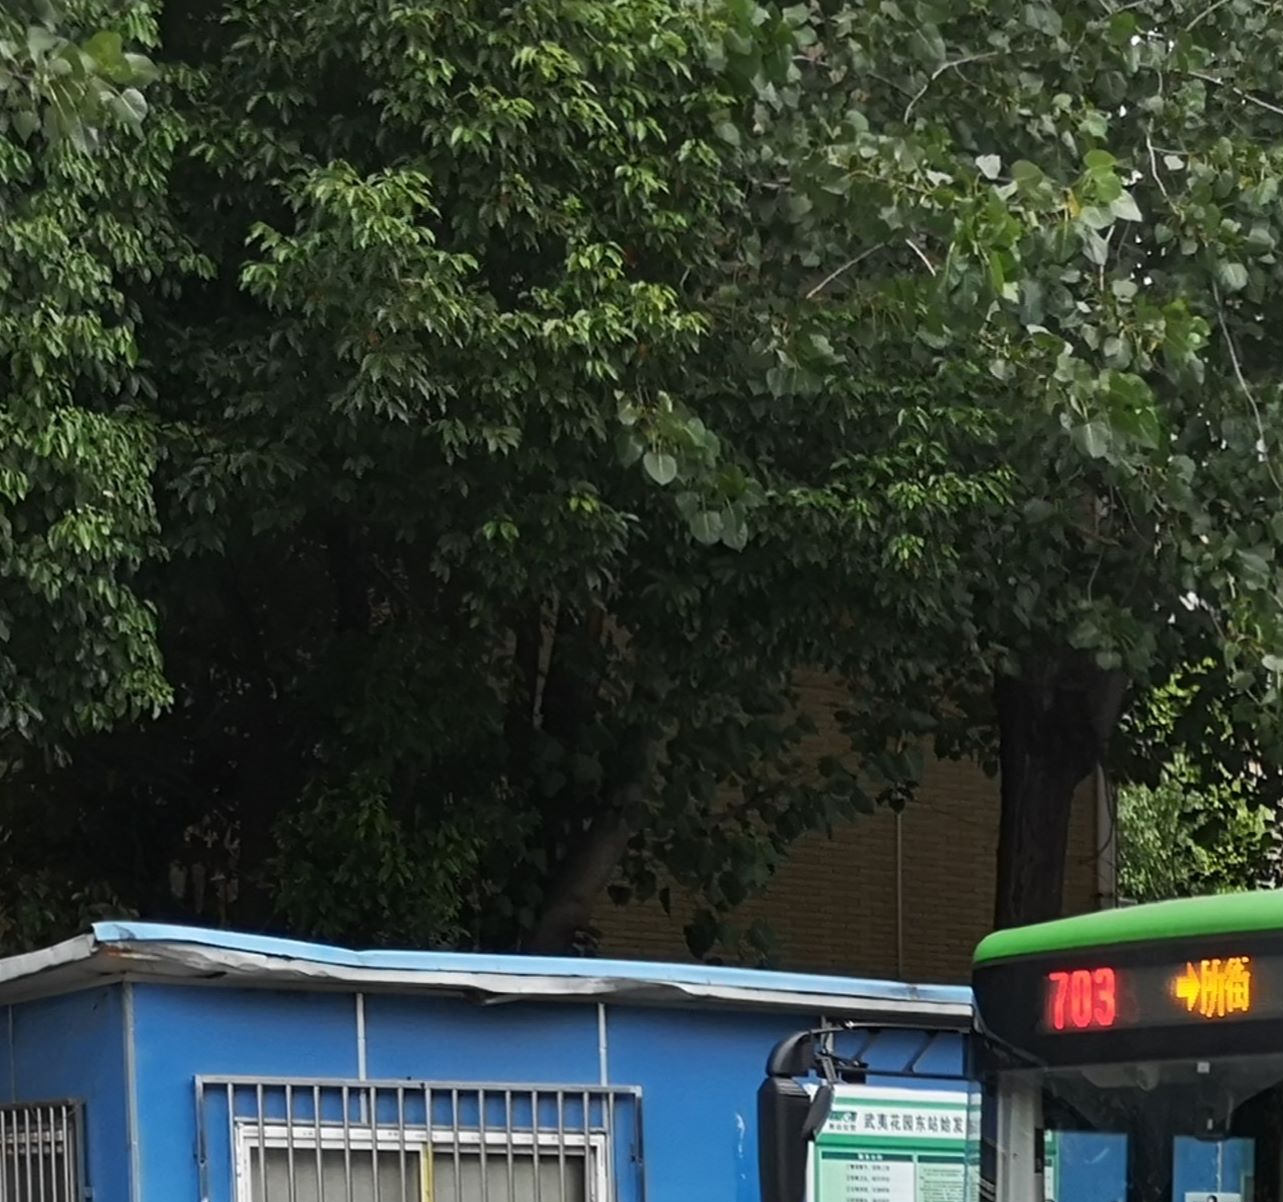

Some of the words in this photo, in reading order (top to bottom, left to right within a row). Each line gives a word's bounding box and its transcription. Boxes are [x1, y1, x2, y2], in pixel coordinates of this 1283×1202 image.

[1048, 967, 1117, 1030] 703
[864, 1112, 978, 1134] 武夷花园东站始发
